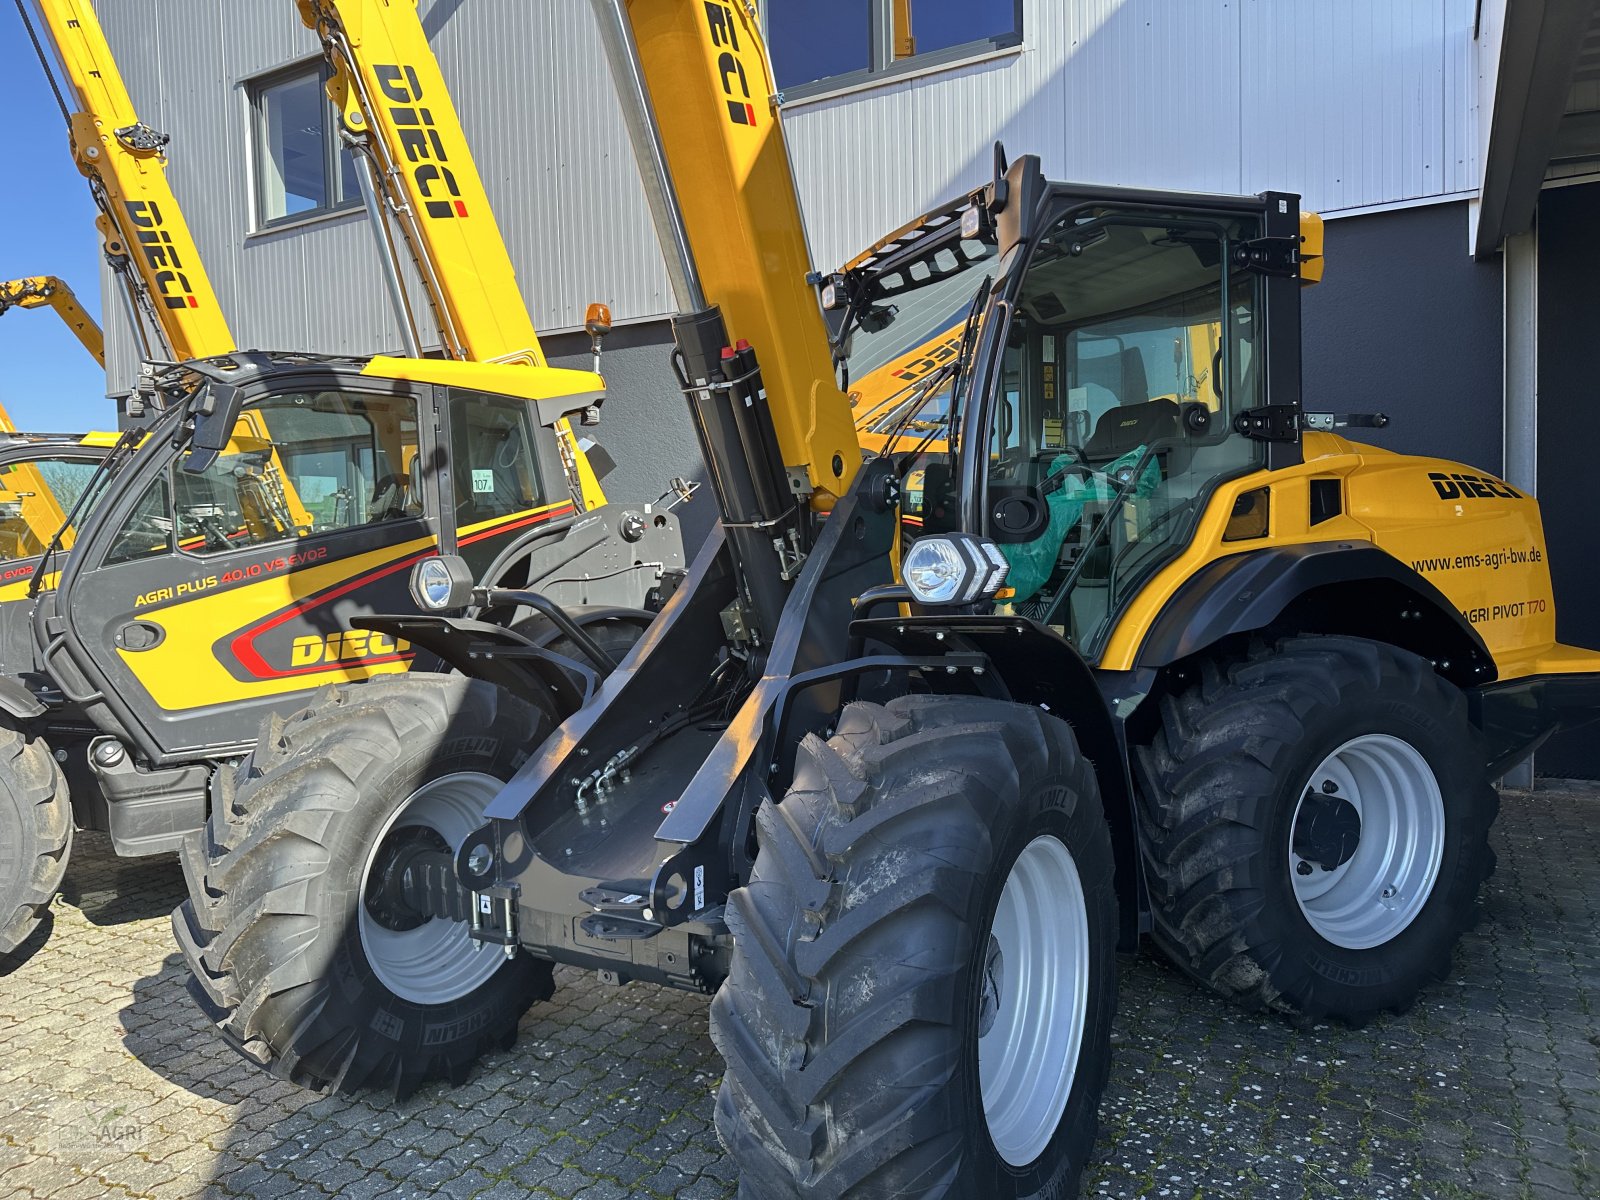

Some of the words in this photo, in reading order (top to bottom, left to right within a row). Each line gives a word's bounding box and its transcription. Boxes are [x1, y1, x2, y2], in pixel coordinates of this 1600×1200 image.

[67, 19, 80, 29] E
[88, 70, 101, 79] F
[703, 0, 757, 127] ECI
[372, 64, 470, 219] DIECI
[123, 200, 199, 310] DIECI
[474, 479, 488, 491] 107
[1427, 472, 1524, 500] DIECI
[4, 565, 34, 580] EVO2
[1411, 546, 1542, 574] www.ems-agri-bw.de
[134, 586, 174, 608] AGRI
[176, 575, 218, 597] PLUS
[221, 564, 262, 583] 40.10
[263, 557, 286, 572] VS
[287, 546, 327, 566] EVO2
[1461, 607, 1490, 624] AGRI
[1492, 602, 1525, 620] PIVOT
[1526, 599, 1546, 615] T70
